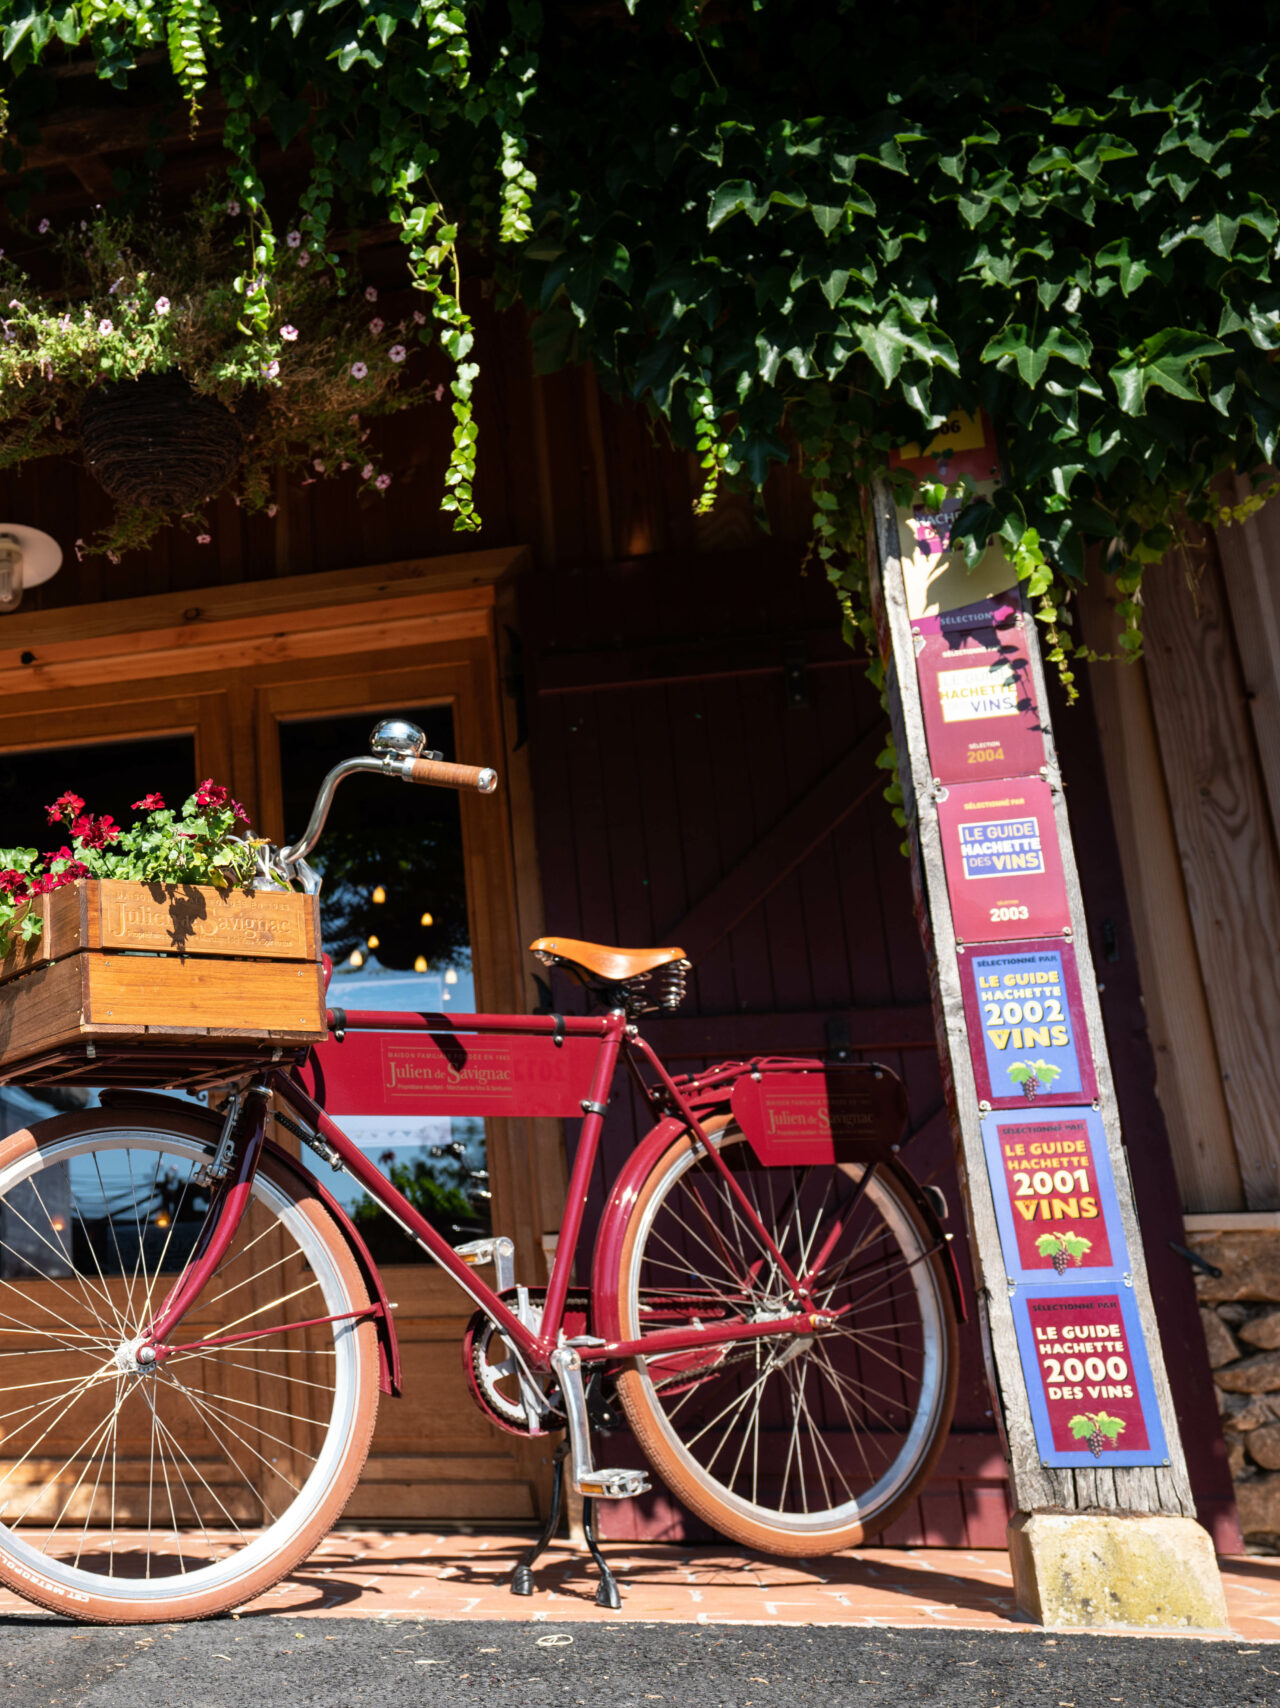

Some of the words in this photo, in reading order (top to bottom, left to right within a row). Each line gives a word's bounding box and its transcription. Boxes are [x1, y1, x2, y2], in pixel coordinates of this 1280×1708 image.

[941, 611, 992, 625] SÉLECTION
[939, 685, 1017, 700] HACHETTE
[970, 696, 1015, 713] VINS
[967, 748, 1005, 764] 2004
[964, 827, 985, 841] LE
[987, 822, 1035, 839] GUIDE
[961, 837, 1042, 857] HACHETTE
[970, 856, 992, 868] DES
[993, 852, 1039, 871] VINS
[989, 905, 1029, 923] 2003
[977, 955, 1037, 968] SÉLECTIONNÉ
[1038, 954, 1058, 963] PAR
[979, 975, 1001, 989] LE
[1003, 970, 1060, 987] GUIDE
[981, 986, 1062, 1002] HACHETTE
[984, 999, 1065, 1026] 2002
[986, 1025, 1070, 1050] VINS
[386, 1062, 433, 1088] Julien
[434, 1069, 446, 1080] de
[447, 1062, 512, 1085] Savignac
[768, 1109, 807, 1135] Julien
[807, 1115, 818, 1125] de
[817, 1107, 873, 1129] Savignac
[1002, 1123, 1063, 1136] SÉLECTIONNÉ
[1065, 1123, 1085, 1132] PAR
[1004, 1143, 1026, 1158] LE
[1030, 1140, 1087, 1155] GUIDE
[1007, 1155, 1090, 1171] HACHETTE
[1013, 1168, 1091, 1197] 2001
[1014, 1197, 1100, 1222] VINS
[1032, 1301, 1095, 1313] SÉLECTIONNÉ
[1097, 1301, 1117, 1310] PAR
[1035, 1326, 1058, 1341] LE
[1061, 1324, 1121, 1340] GUIDE
[1039, 1341, 1124, 1355] HACHETTE
[1043, 1356, 1129, 1384] 2000
[1048, 1386, 1084, 1401] DES
[1087, 1385, 1134, 1400] VINS
